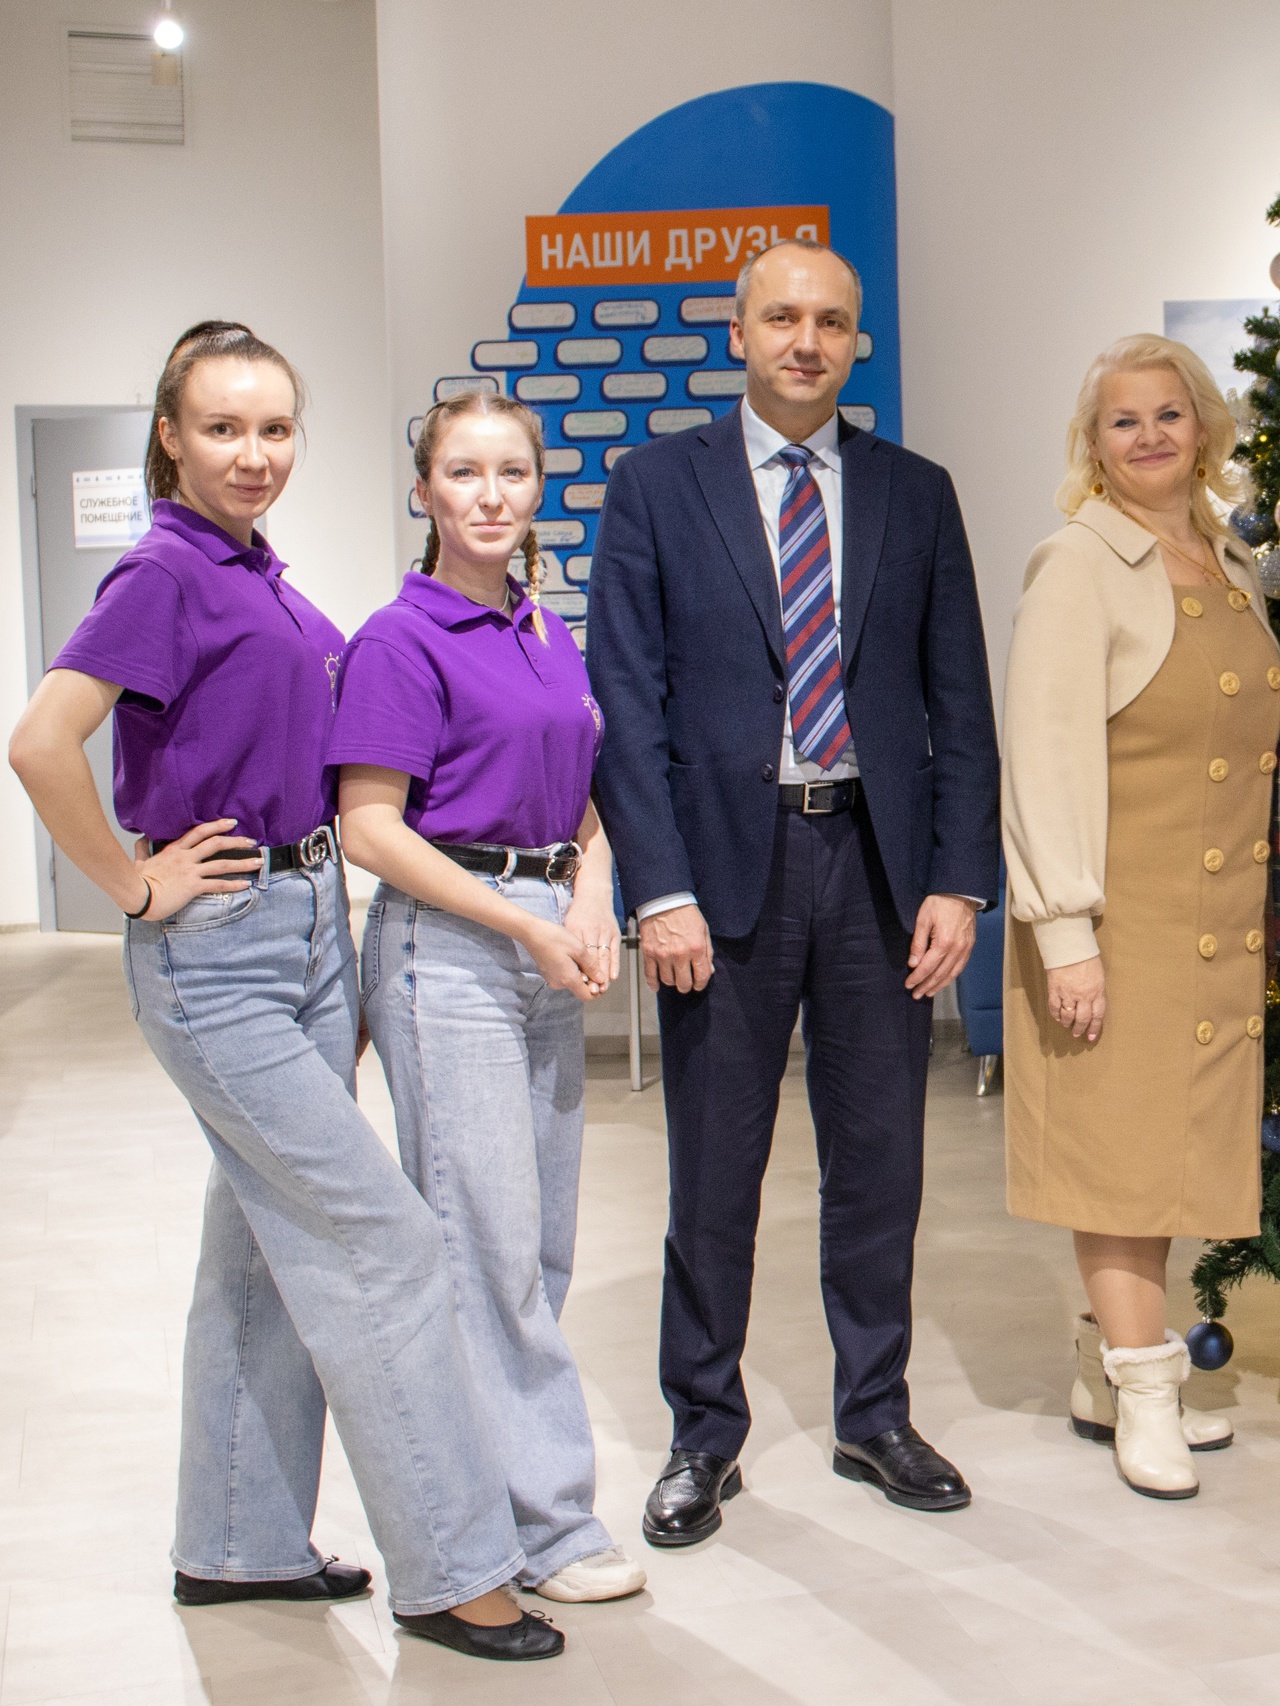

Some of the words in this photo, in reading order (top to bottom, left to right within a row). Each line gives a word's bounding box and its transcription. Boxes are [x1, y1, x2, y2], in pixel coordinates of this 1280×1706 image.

[541, 230, 650, 270] НАШИ
[80, 496, 138, 508] СЛУЖЕБНОЕ
[80, 511, 143, 523] ПОМЕЩЕНИЕ
